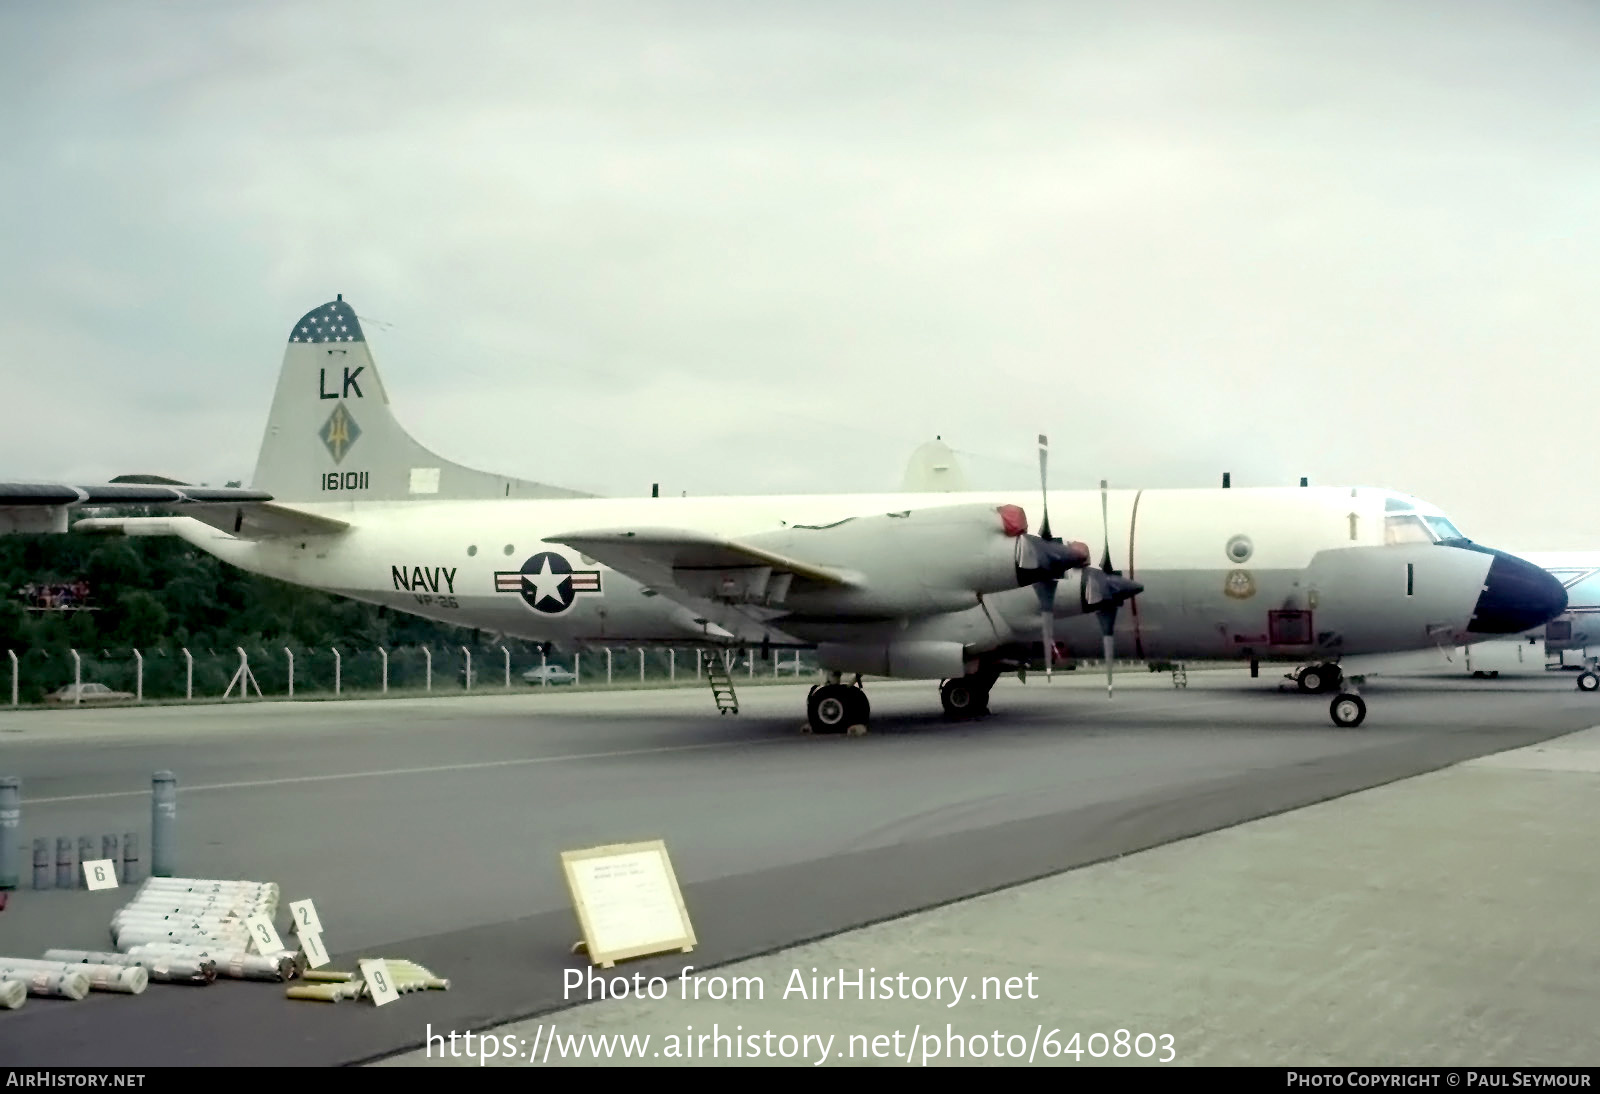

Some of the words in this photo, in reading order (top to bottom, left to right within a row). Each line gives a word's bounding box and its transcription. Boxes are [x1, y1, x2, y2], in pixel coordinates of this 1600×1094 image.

[319, 366, 365, 400] LK
[322, 471, 369, 491] 161011
[391, 565, 457, 594] NAVY
[413, 593, 460, 609] VP-26
[94, 866, 106, 882] 6
[298, 906, 311, 926] 2
[256, 923, 272, 944] 3
[308, 937, 319, 957] 1
[373, 970, 388, 993] 9
